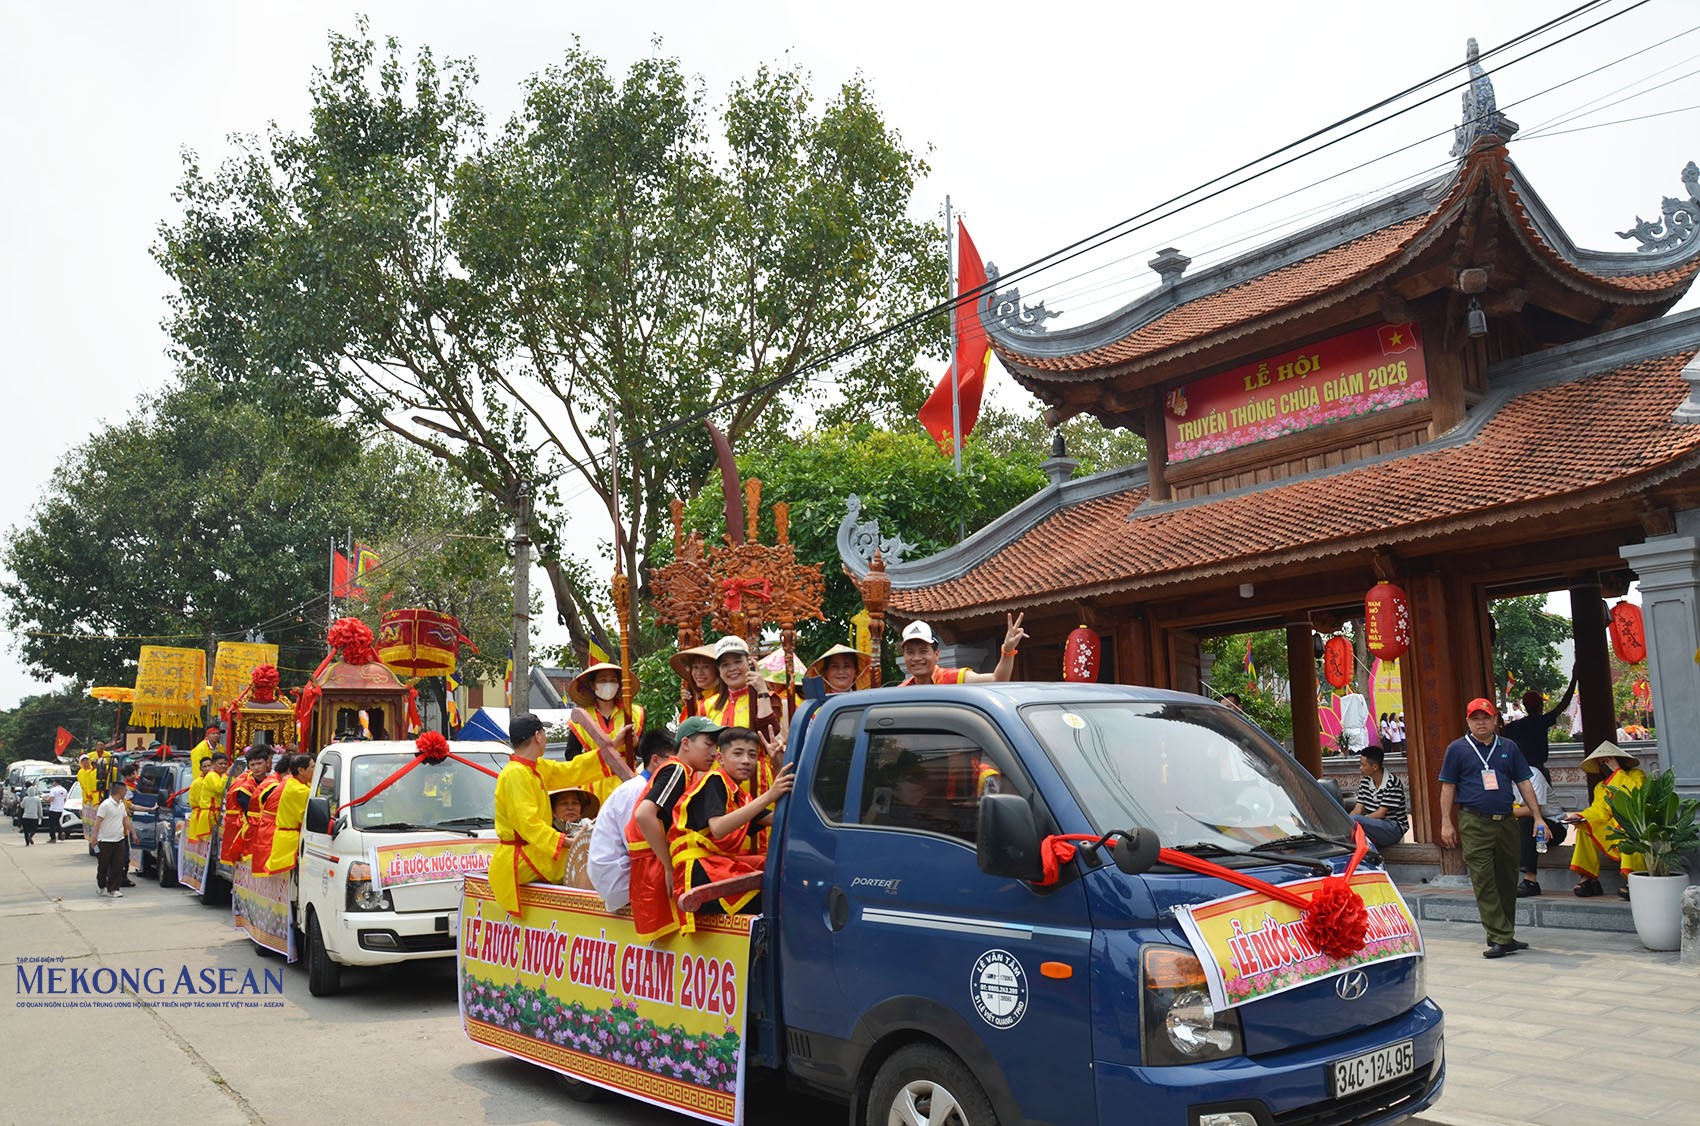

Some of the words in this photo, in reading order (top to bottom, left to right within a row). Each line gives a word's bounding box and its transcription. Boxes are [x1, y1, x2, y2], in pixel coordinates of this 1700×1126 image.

[1244, 362, 1271, 391] LỄ
[1277, 354, 1321, 381] HỘI
[1178, 408, 1228, 442] TRUYỀN
[1230, 395, 1276, 428] THỐNG
[1280, 384, 1321, 415] CHÙA
[1323, 373, 1365, 403] GIÁM
[1367, 360, 1408, 391] 2026
[389, 852, 402, 878] LỄ
[403, 851, 430, 875] RƯỚC
[431, 848, 460, 873] NƯỚC
[460, 848, 486, 870] CHÙA
[850, 877, 891, 888] PORTER
[465, 899, 482, 960] LỄ
[481, 912, 521, 970] RƯỚC
[521, 920, 568, 981] NƯỚC
[569, 928, 618, 994] CHÙA
[621, 940, 676, 1006] GIÁM
[680, 952, 738, 1018] 2026
[1227, 918, 1261, 980] LỄ
[1247, 911, 1303, 973] RƯỚC
[1378, 901, 1412, 938] 2026
[977, 959, 987, 973] LÊ
[985, 952, 1003, 963] VĂN
[1005, 956, 1021, 977] TÂM
[1338, 1044, 1411, 1093] 34C-124.95
